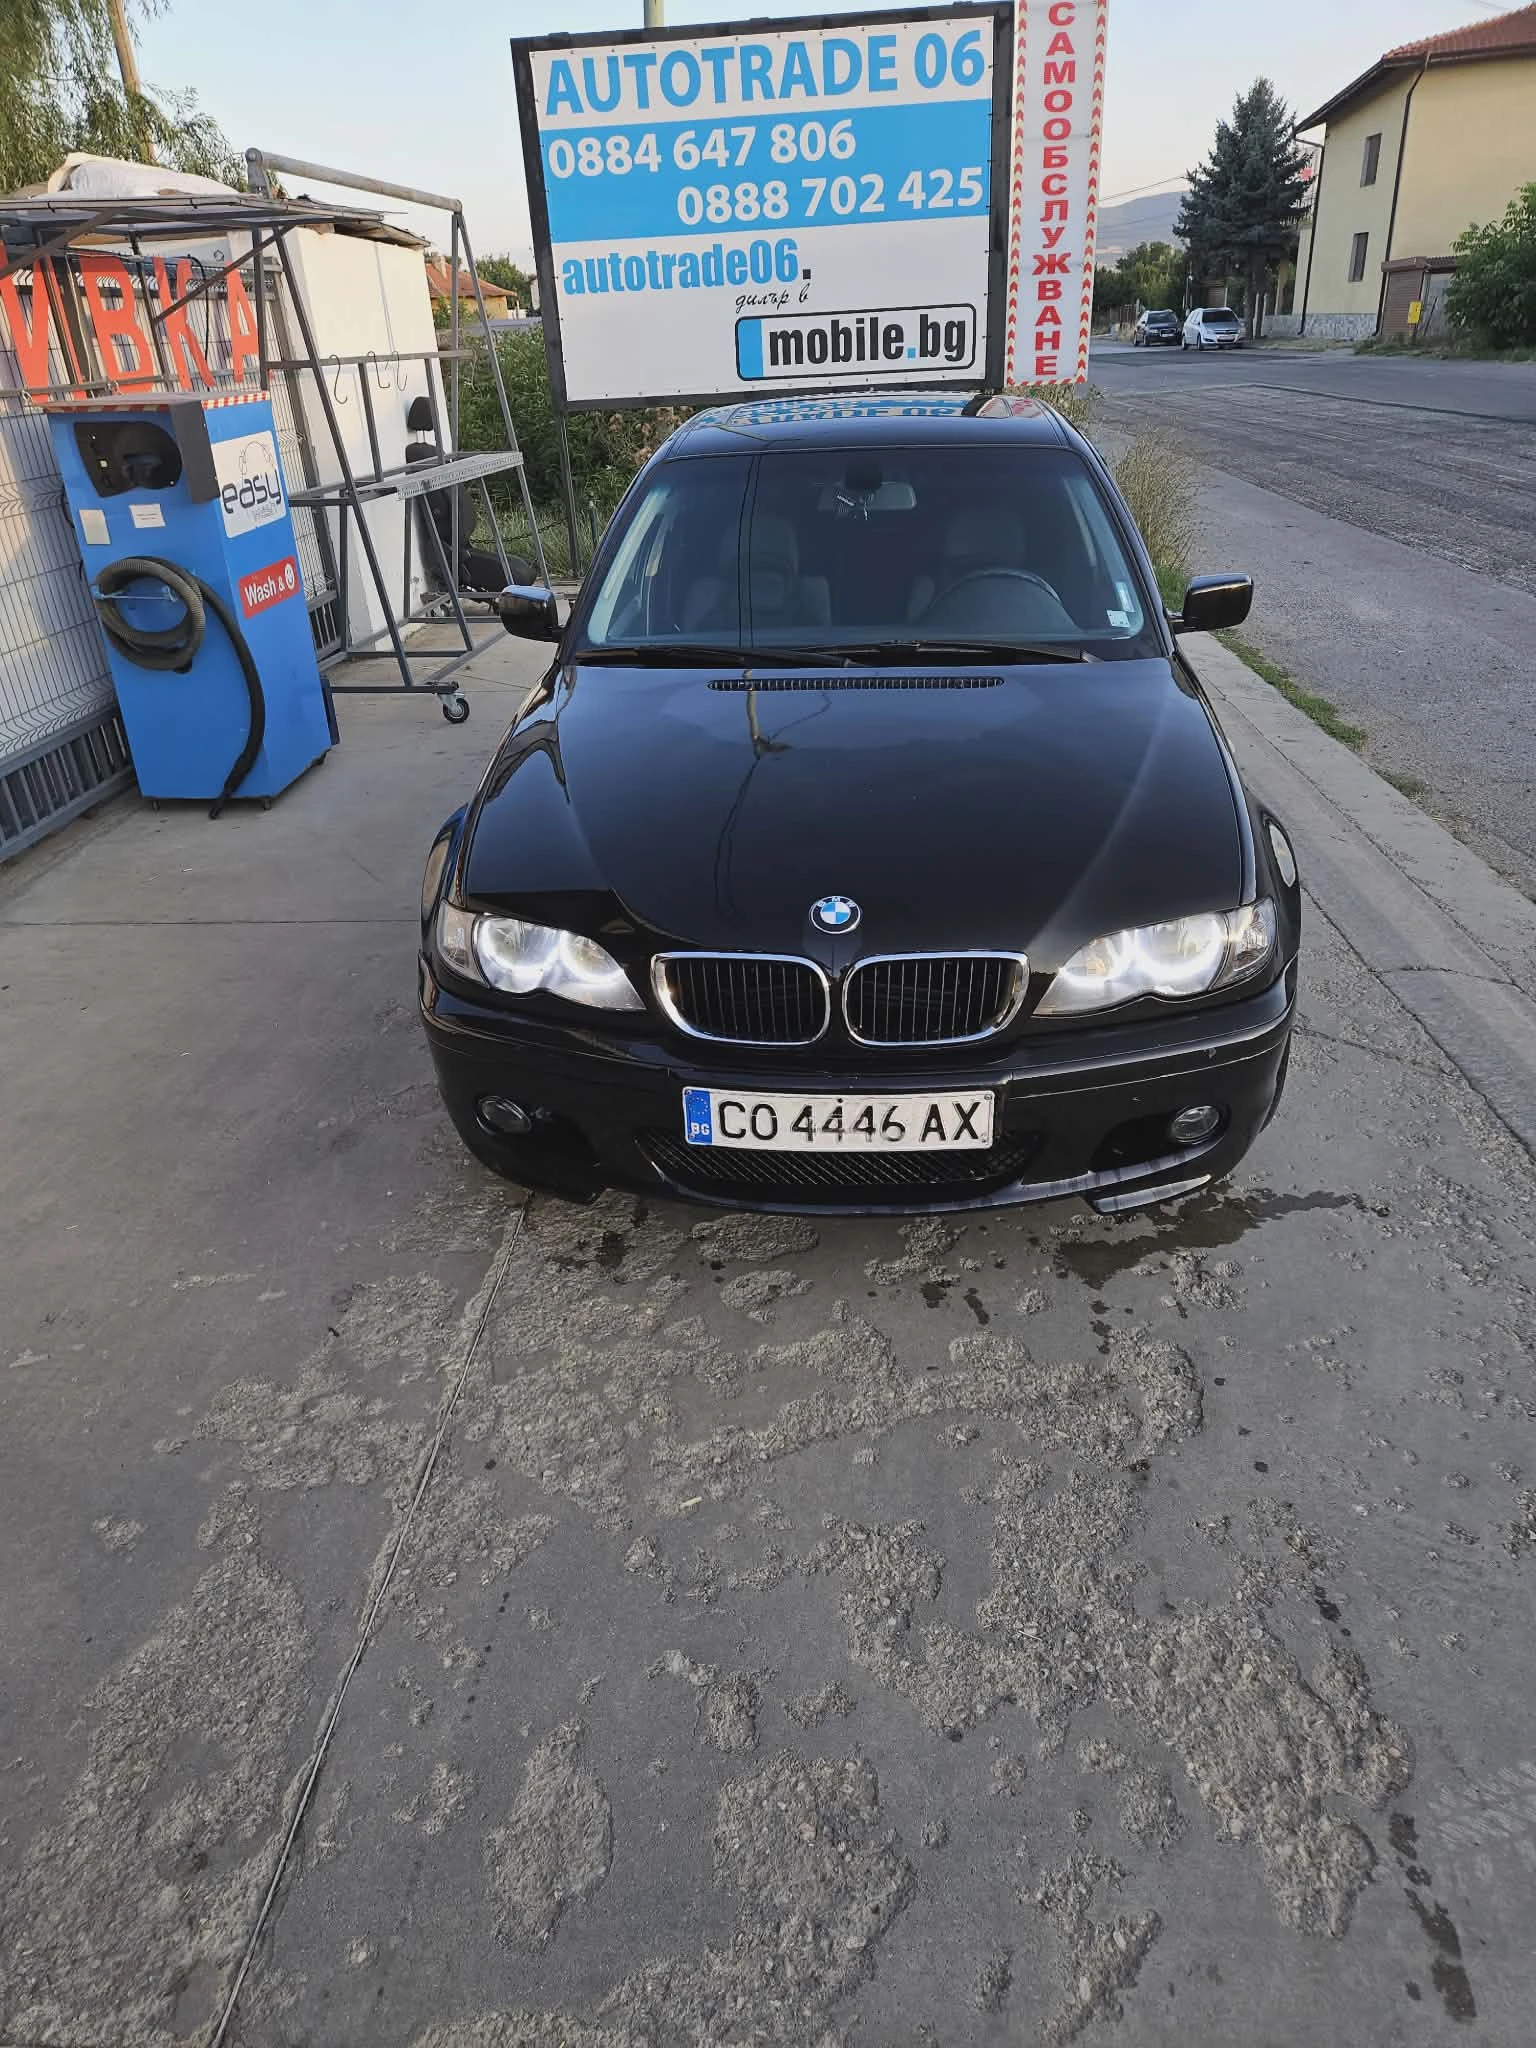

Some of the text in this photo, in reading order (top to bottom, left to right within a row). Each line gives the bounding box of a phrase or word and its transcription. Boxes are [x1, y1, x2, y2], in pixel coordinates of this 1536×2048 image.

[545, 30, 985, 116] AUTOTRADE 06
[548, 119, 857, 179] 0884 647 806
[677, 167, 984, 226] 0888 702 425
[1032, 2, 1077, 376] САМООБСЛУЖВАНЕ
[768, 313, 966, 367] mobile.bg
[222, 469, 282, 514] easy
[244, 575, 286, 608] Wash &
[690, 1121, 711, 1136] BG
[718, 1100, 982, 1142] CO 4446 AX
